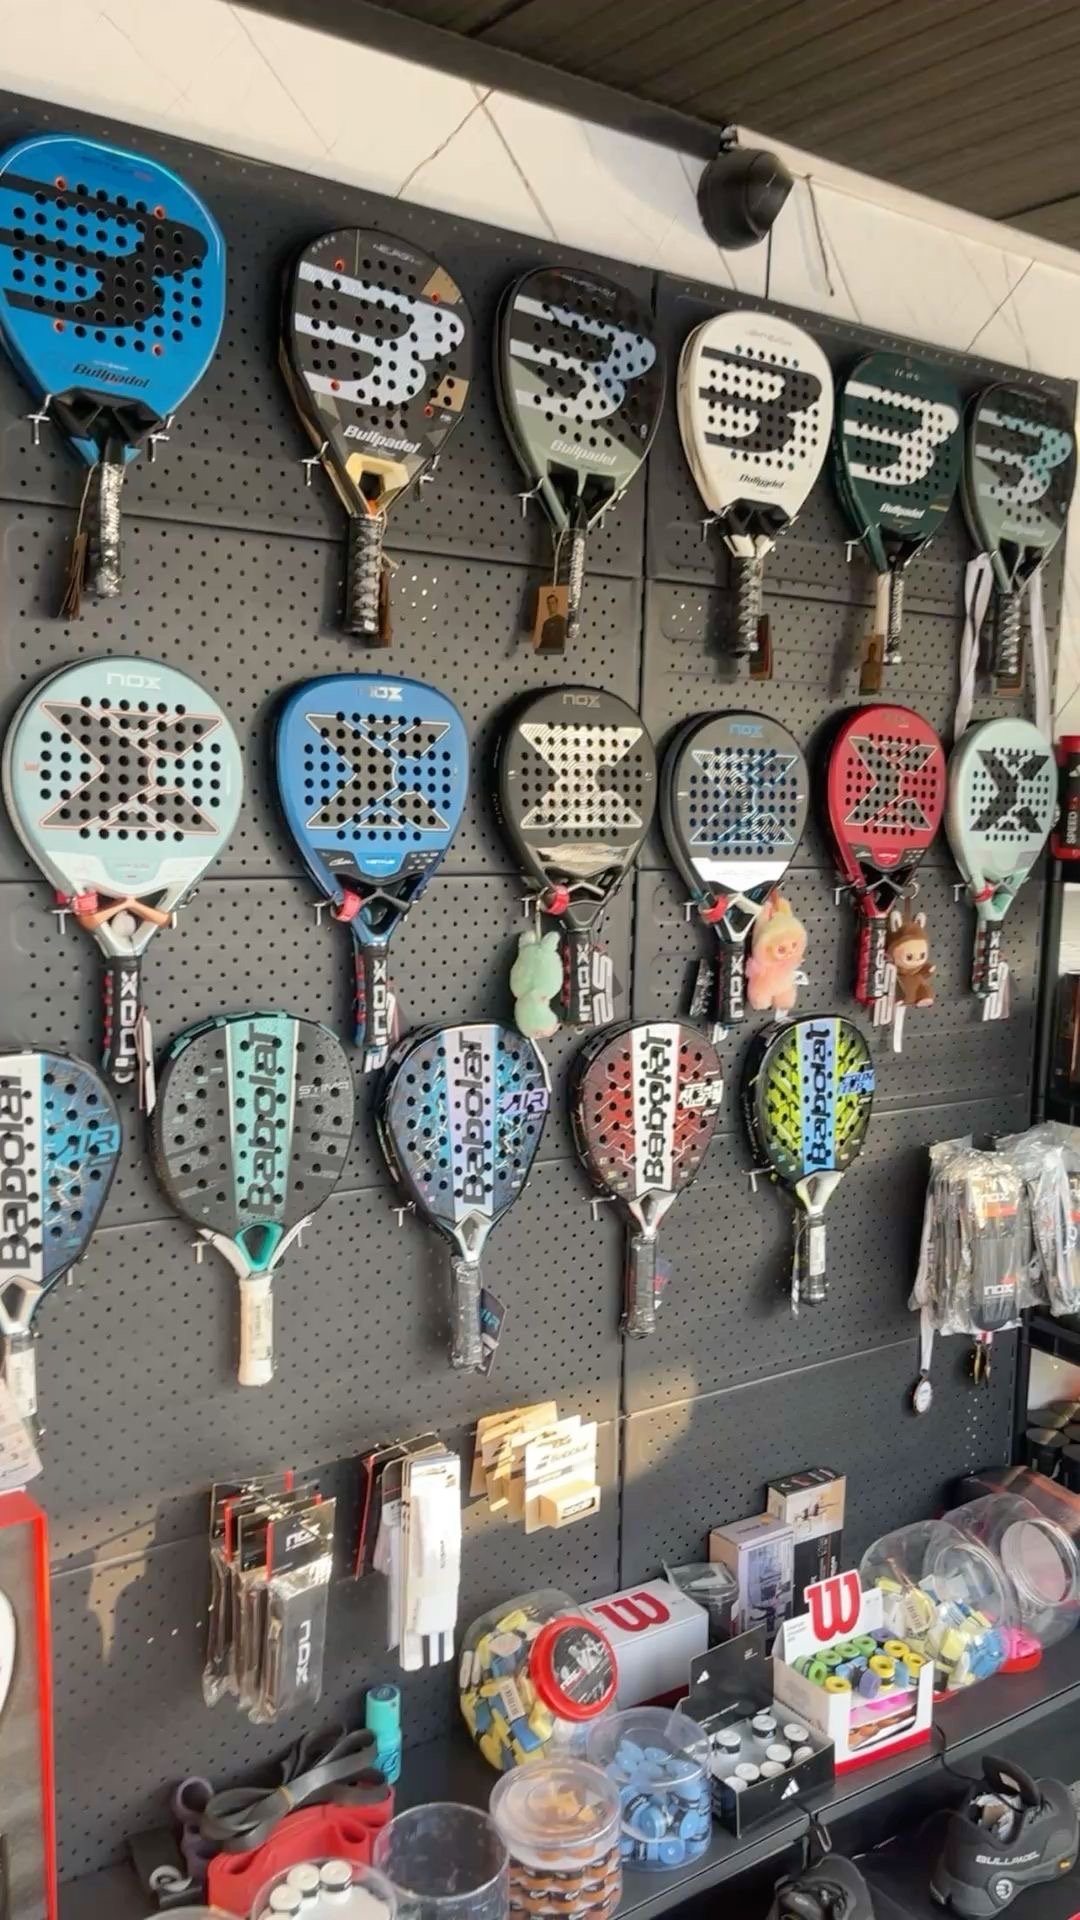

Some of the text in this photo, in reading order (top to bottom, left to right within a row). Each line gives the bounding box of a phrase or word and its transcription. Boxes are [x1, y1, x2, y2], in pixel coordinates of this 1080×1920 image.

[73, 362, 152, 389] Bullpadel
[343, 423, 421, 454] Bullpadel
[550, 438, 617, 467] Bullpadel
[879, 502, 926, 520] Bullpadel
[1066, 811, 1078, 844] SPEED
[644, 1028, 666, 1185] Babolat
[810, 1023, 829, 1166] Babolat
[247, 1022, 278, 1216] Babolat
[459, 1031, 486, 1205] Babolat
[56, 1130, 115, 1158] AIR
